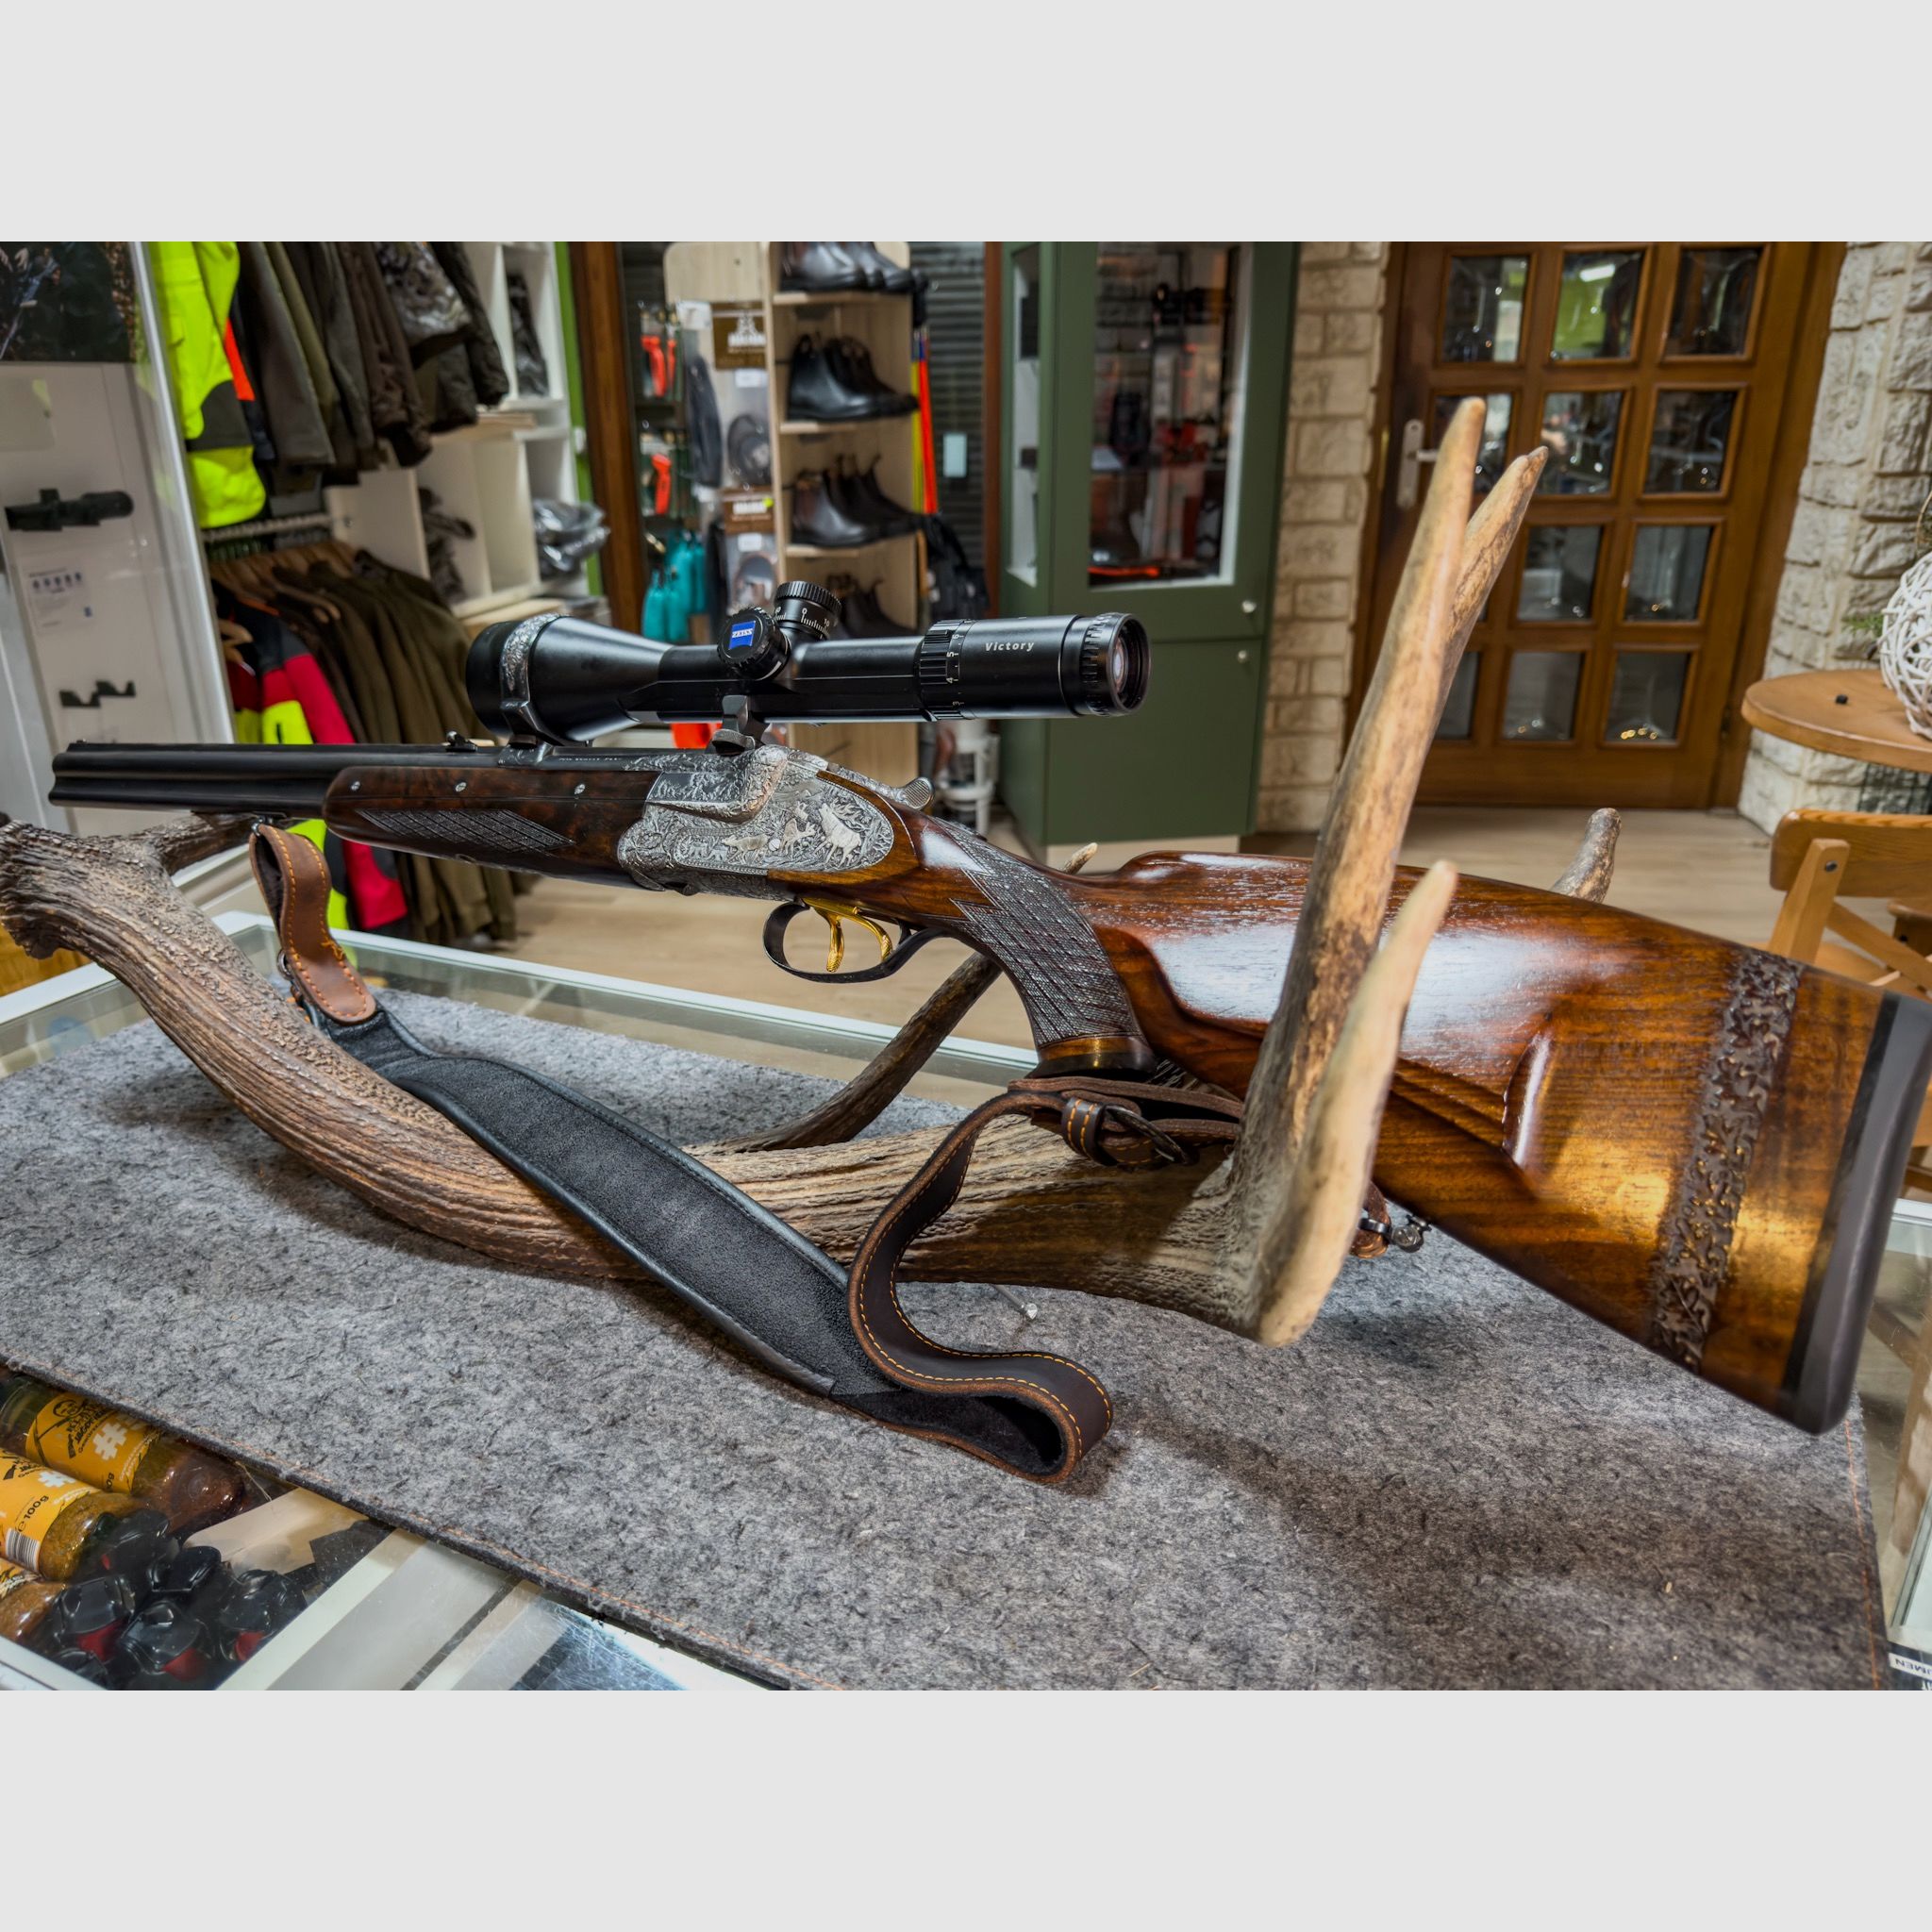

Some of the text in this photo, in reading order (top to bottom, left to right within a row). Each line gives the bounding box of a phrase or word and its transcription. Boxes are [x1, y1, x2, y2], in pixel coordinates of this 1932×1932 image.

[732, 628, 752, 638] ZEISS
[985, 641, 1035, 652] Victory
[24, 1495, 49, 1519] 100g
